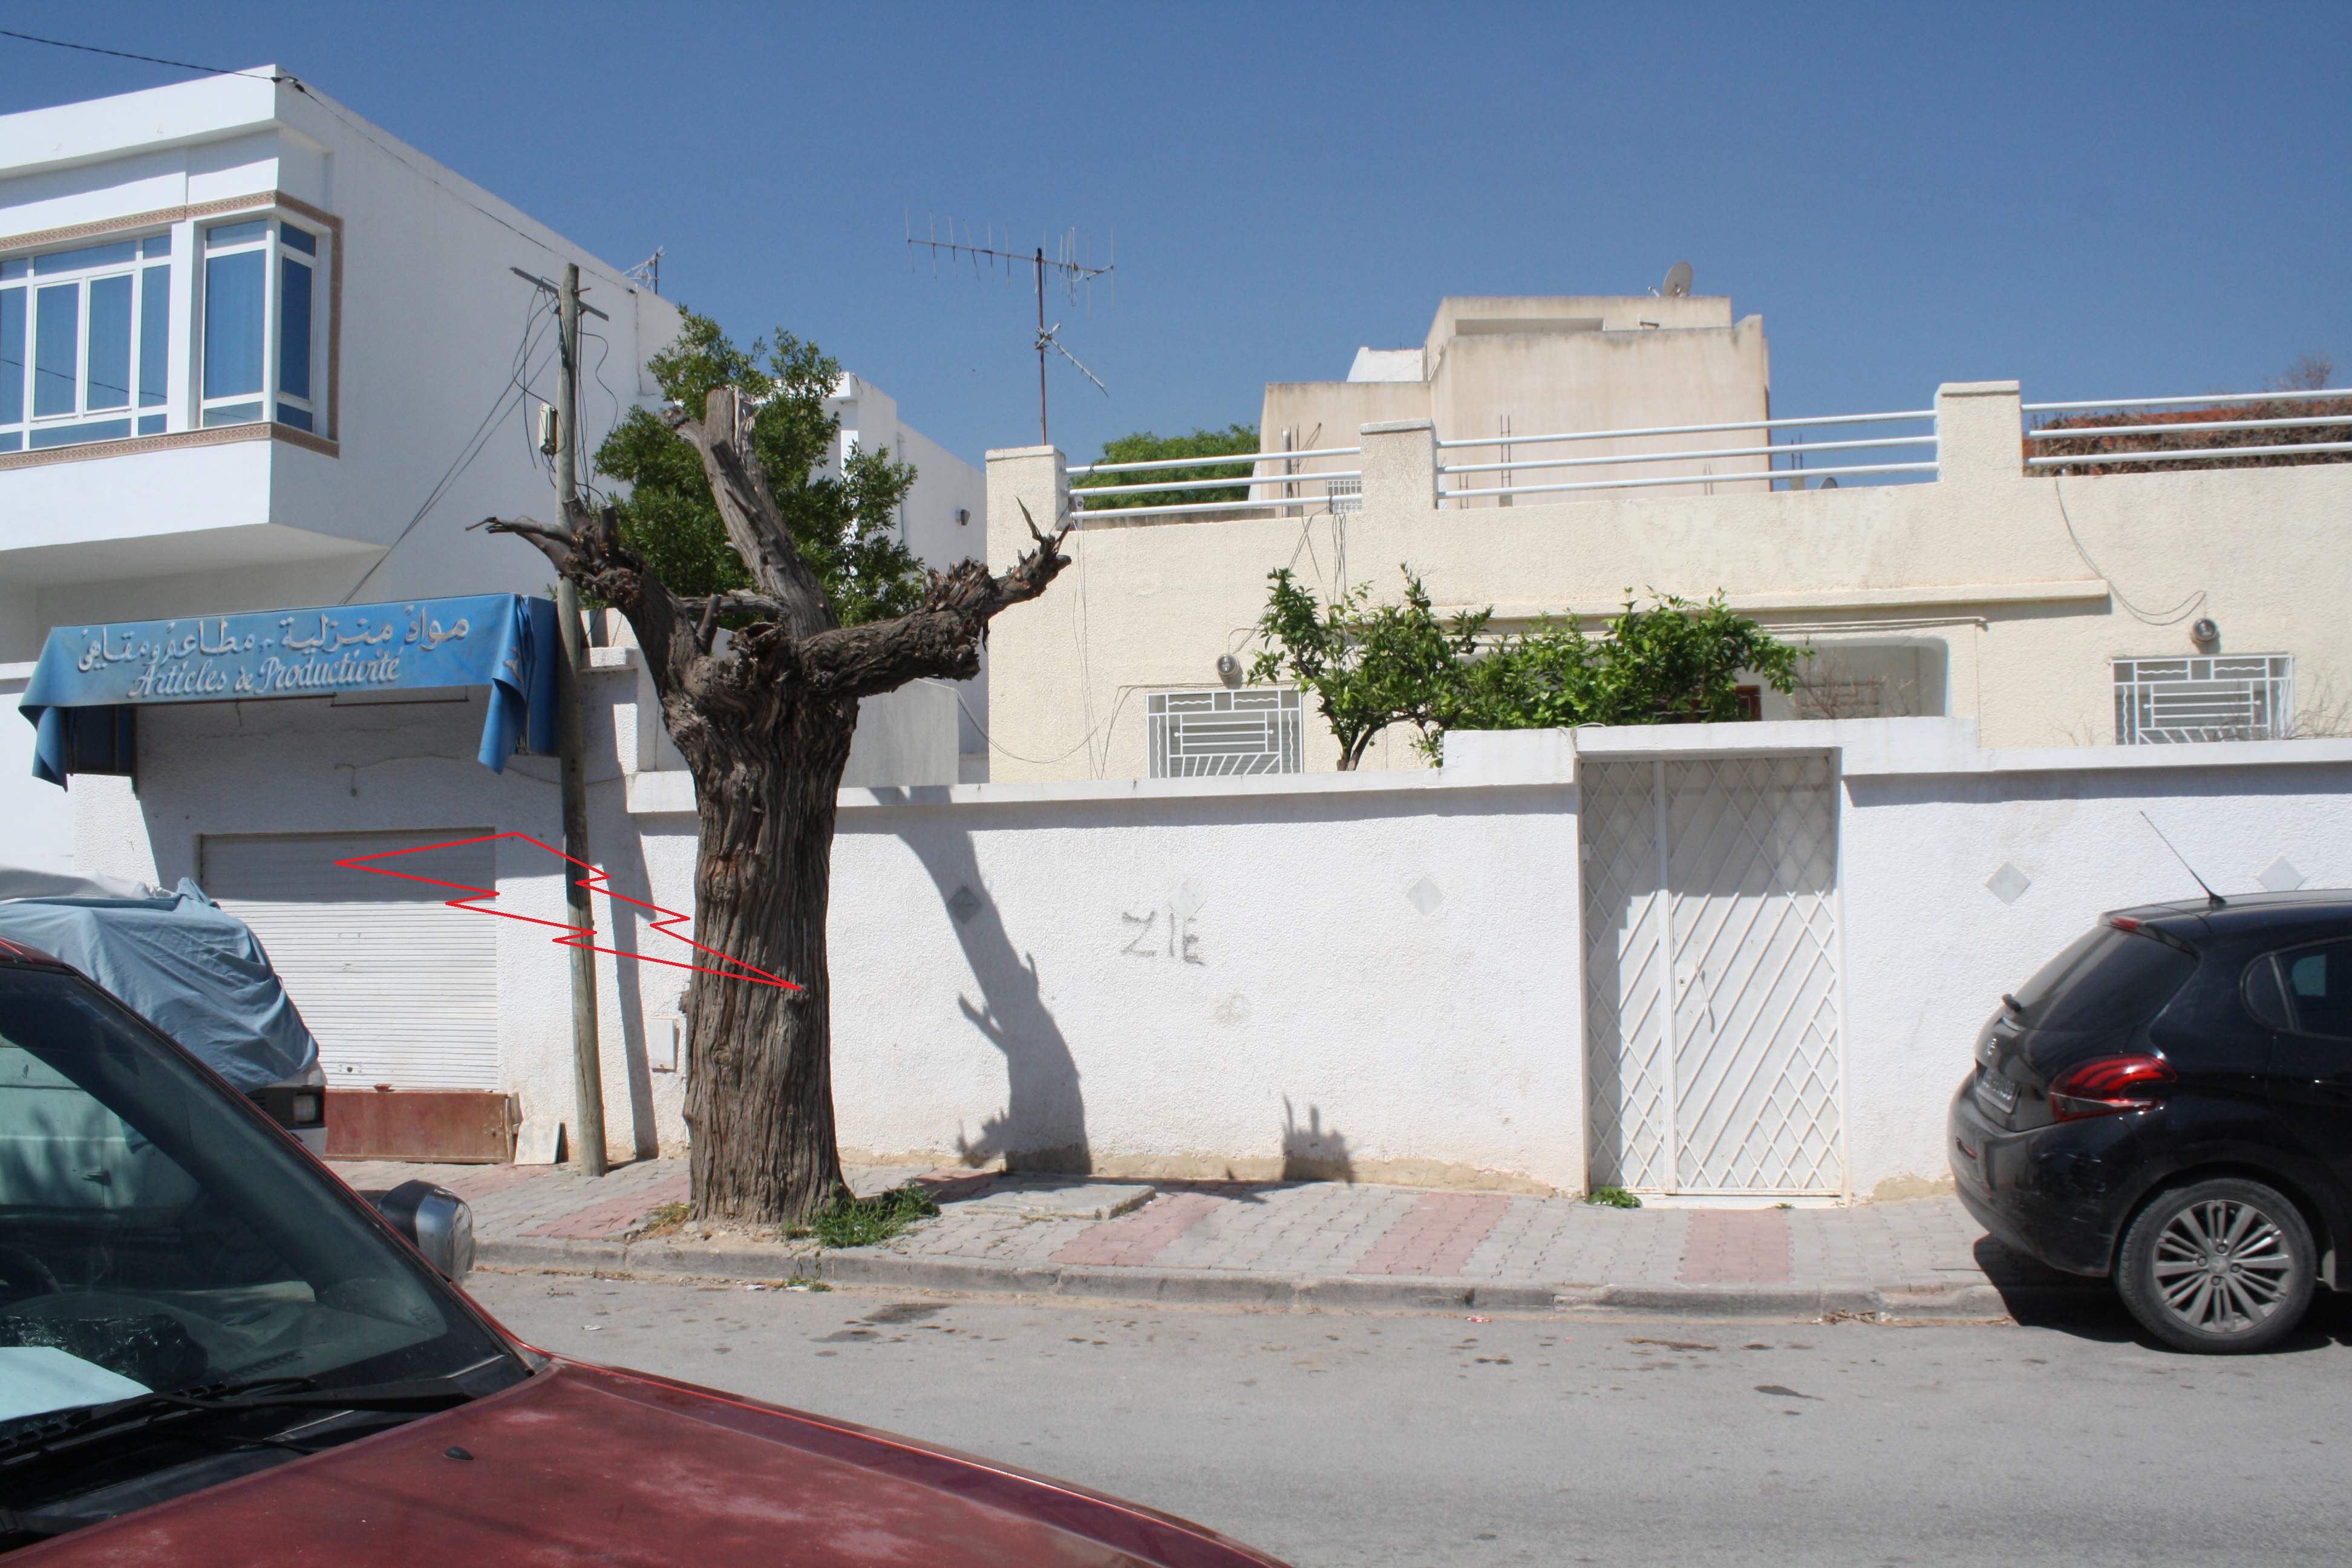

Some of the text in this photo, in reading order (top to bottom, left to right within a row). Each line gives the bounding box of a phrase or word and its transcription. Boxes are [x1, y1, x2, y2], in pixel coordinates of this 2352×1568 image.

[278, 612, 393, 655] منزلية
[126, 647, 400, 697] Articles de Productivité
